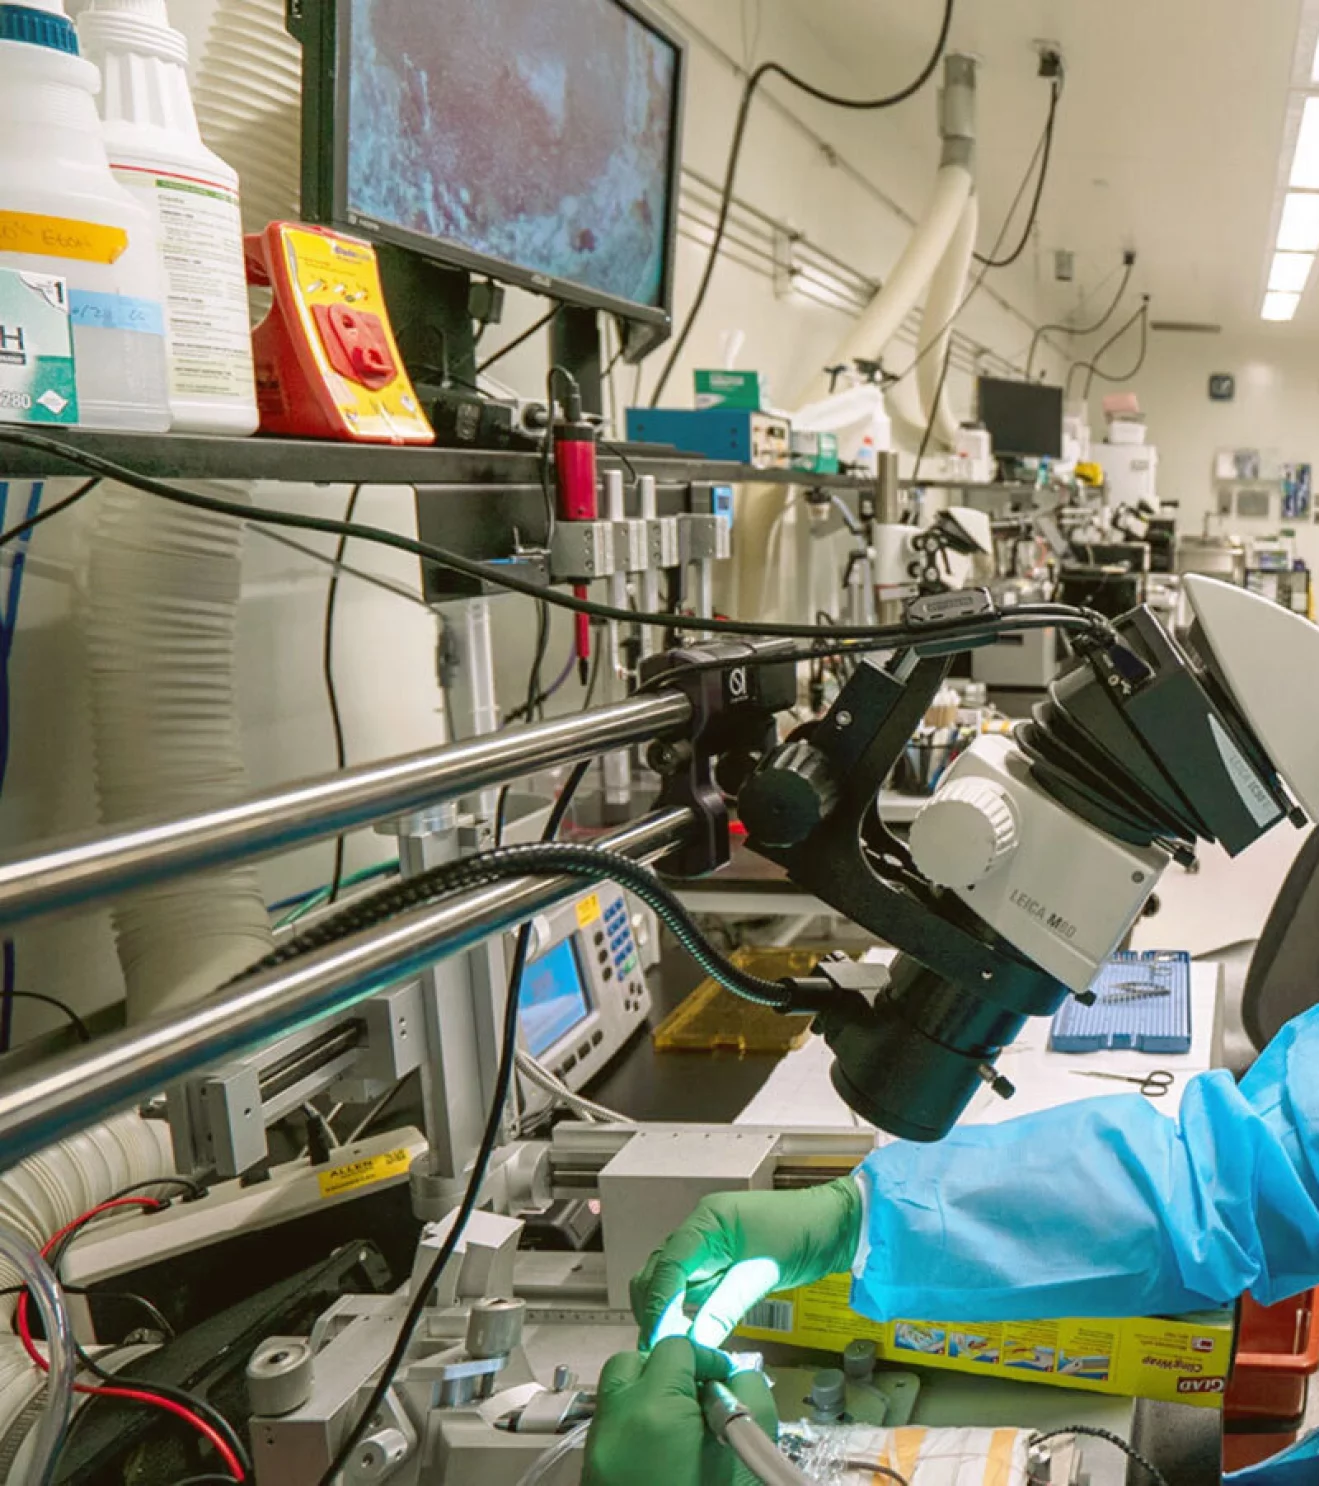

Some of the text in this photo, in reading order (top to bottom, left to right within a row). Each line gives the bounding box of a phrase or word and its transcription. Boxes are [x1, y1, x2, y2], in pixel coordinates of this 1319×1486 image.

[1009, 889, 1046, 920] LEICA
[330, 1160, 373, 1179] ALLEN
[1178, 1378, 1225, 1392] GLAD
